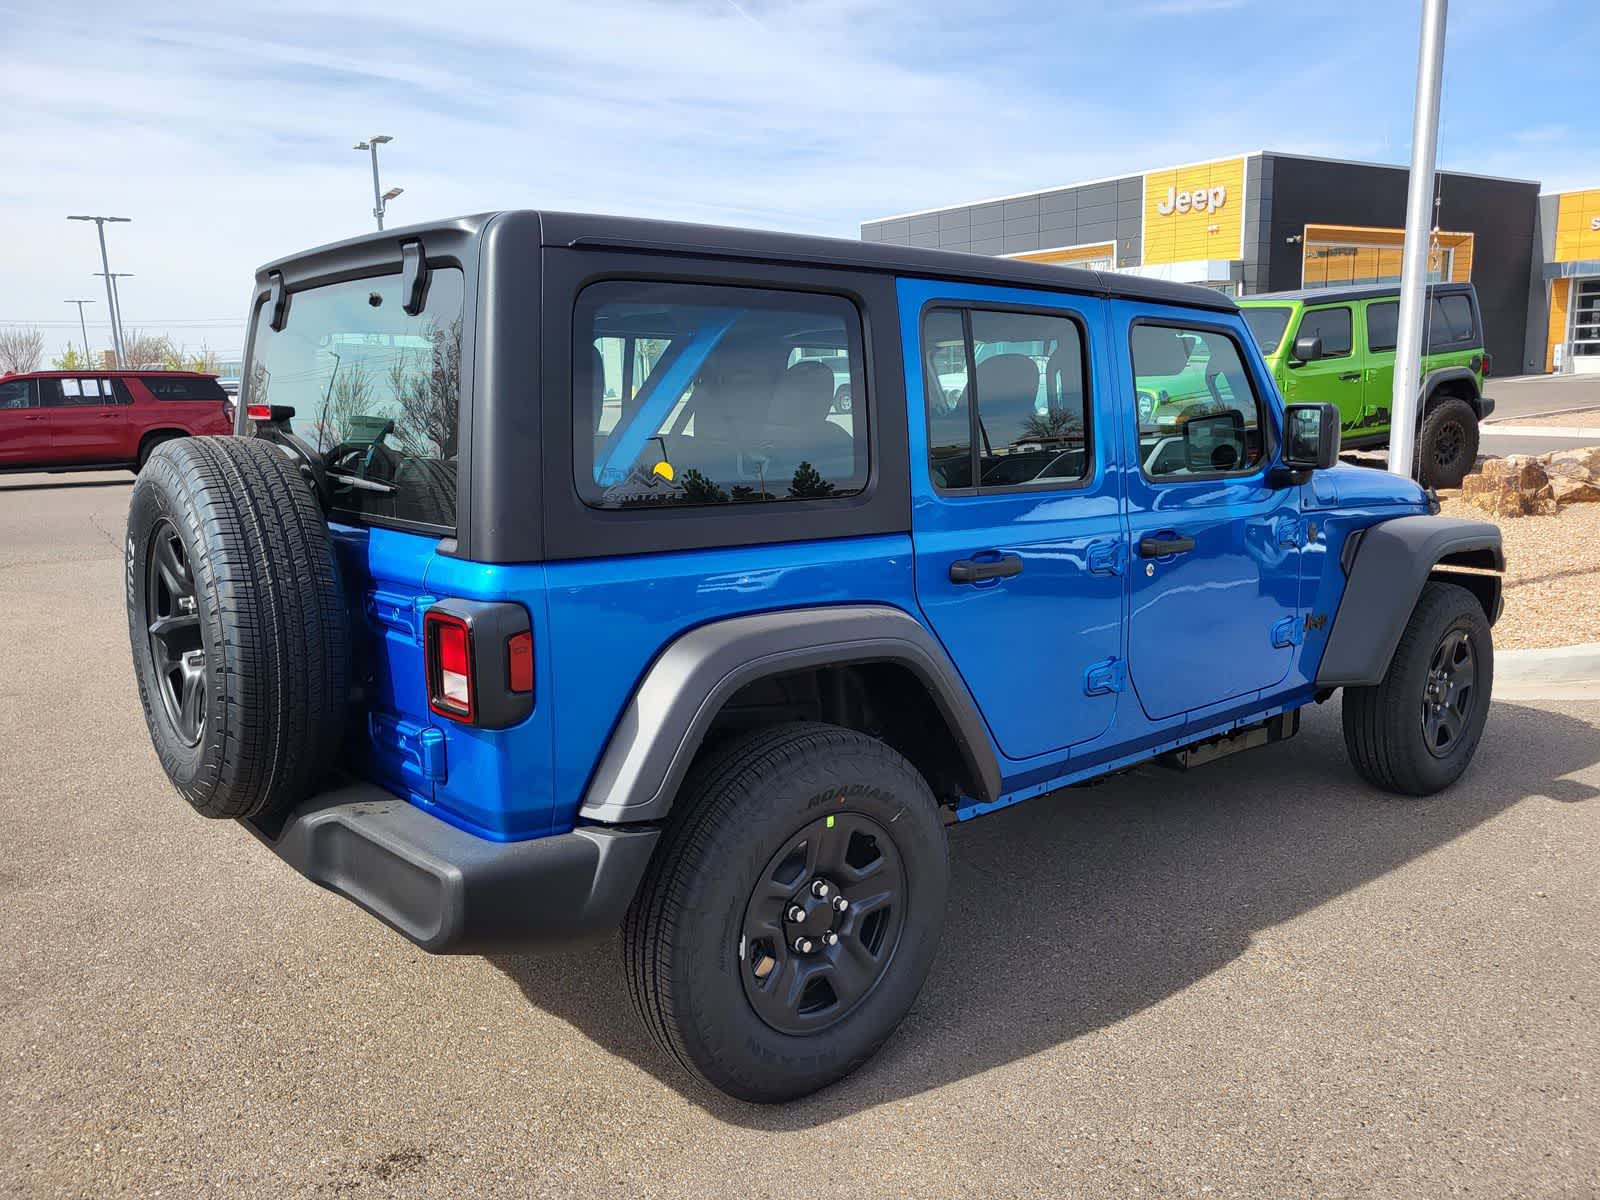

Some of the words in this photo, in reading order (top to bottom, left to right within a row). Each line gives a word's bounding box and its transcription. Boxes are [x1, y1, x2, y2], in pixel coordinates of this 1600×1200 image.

[1158, 184, 1226, 216] Jeep
[605, 493, 659, 503] SANTA
[664, 492, 684, 500] FE
